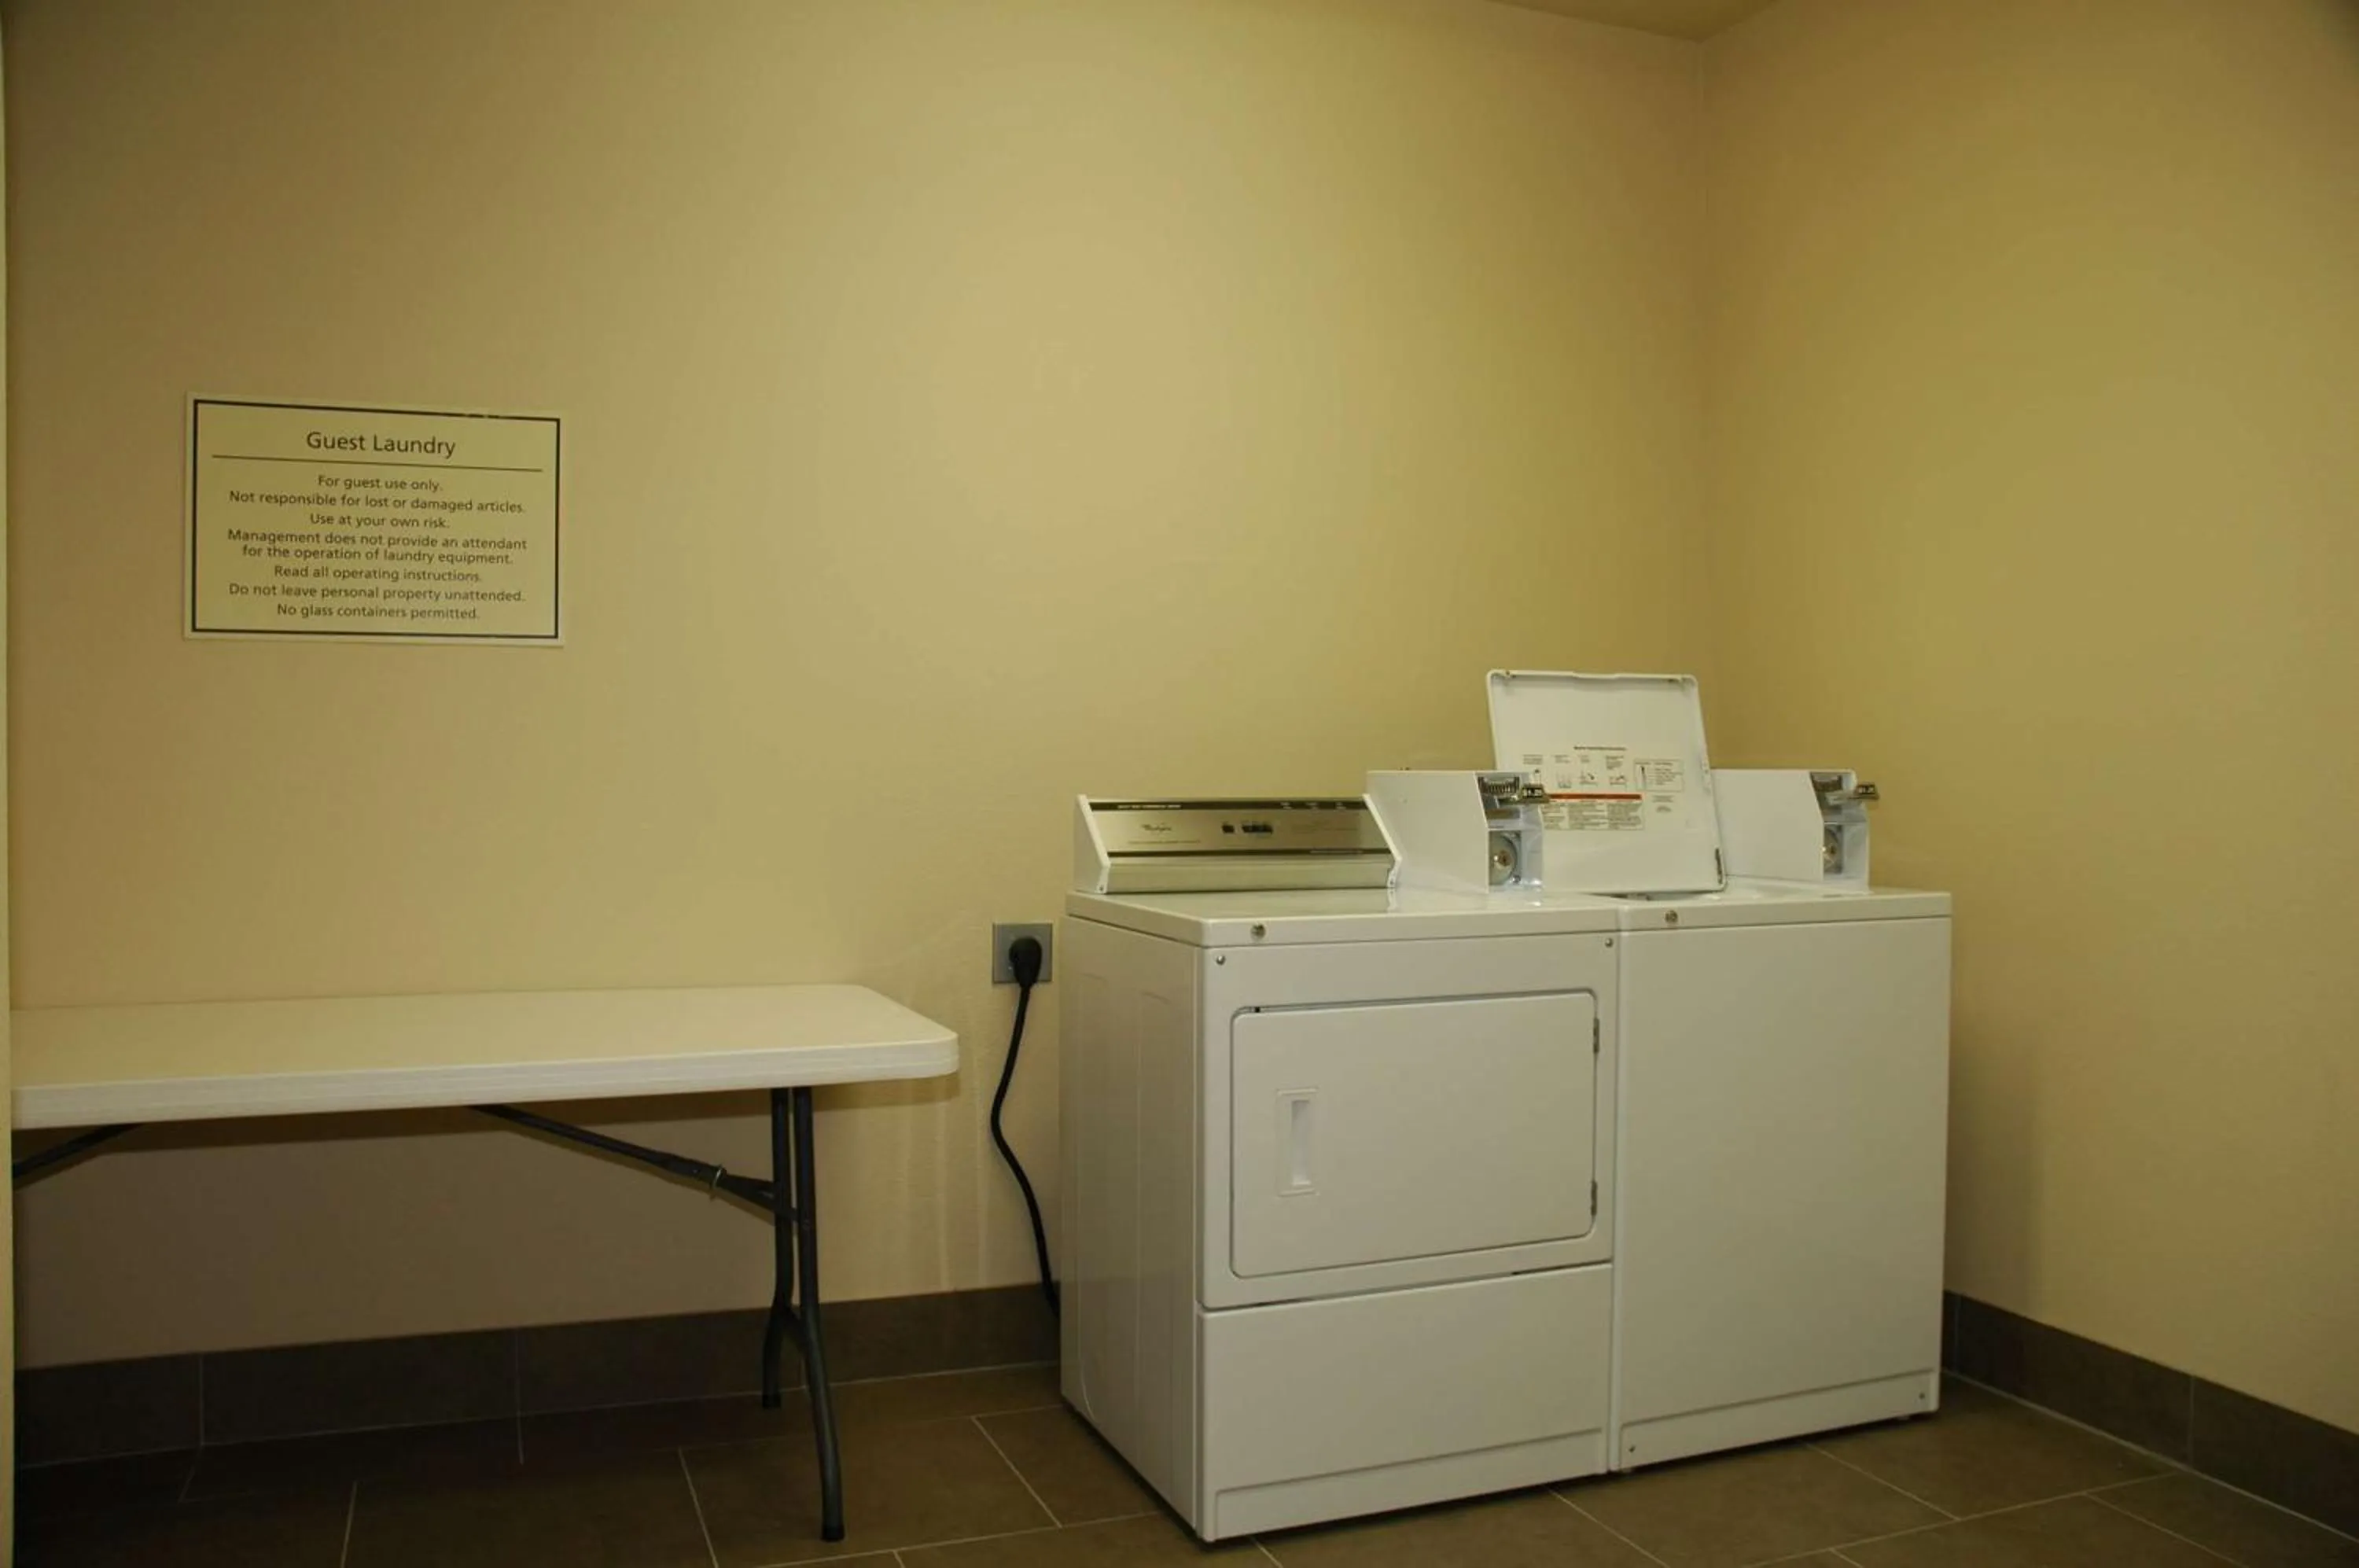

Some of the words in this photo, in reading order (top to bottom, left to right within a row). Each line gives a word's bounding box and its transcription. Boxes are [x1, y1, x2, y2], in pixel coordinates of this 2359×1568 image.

[307, 431, 366, 451] Guest
[374, 434, 455, 459] Laundry
[318, 475, 340, 488] For
[344, 478, 381, 490] guest
[385, 480, 407, 490] use
[410, 480, 443, 493] only.
[230, 491, 254, 502] Not
[259, 493, 337, 506] responsible
[340, 495, 361, 506] for
[365, 495, 389, 507] lost
[392, 499, 407, 509] or
[410, 498, 473, 513] damaged
[477, 501, 525, 513] articles.
[310, 513, 334, 525] Use
[338, 516, 351, 526] at
[355, 517, 386, 528] your
[390, 518, 419, 528] own
[424, 517, 449, 528] risk.
[228, 529, 320, 545] Management
[325, 532, 356, 545] does
[360, 535, 382, 545] not
[388, 535, 438, 548] provide
[442, 538, 458, 547] an
[462, 538, 526, 550] attendant
[243, 545, 263, 557] for
[267, 546, 290, 558] the
[294, 547, 361, 561] operation
[365, 549, 380, 560] of
[384, 549, 434, 565] laundry
[438, 552, 513, 565] equipment.
[274, 565, 309, 577] Read
[313, 566, 329, 578] all
[333, 568, 399, 583] operating
[403, 569, 481, 582] instructions.
[230, 583, 248, 594] Do
[253, 585, 277, 596] not
[282, 584, 318, 597] leave
[321, 587, 379, 600] personal
[383, 590, 441, 602] property
[444, 591, 525, 602] unattended.
[278, 604, 296, 615] No
[300, 604, 333, 618] glass
[337, 605, 407, 617] containers
[410, 608, 480, 620] permitted.
